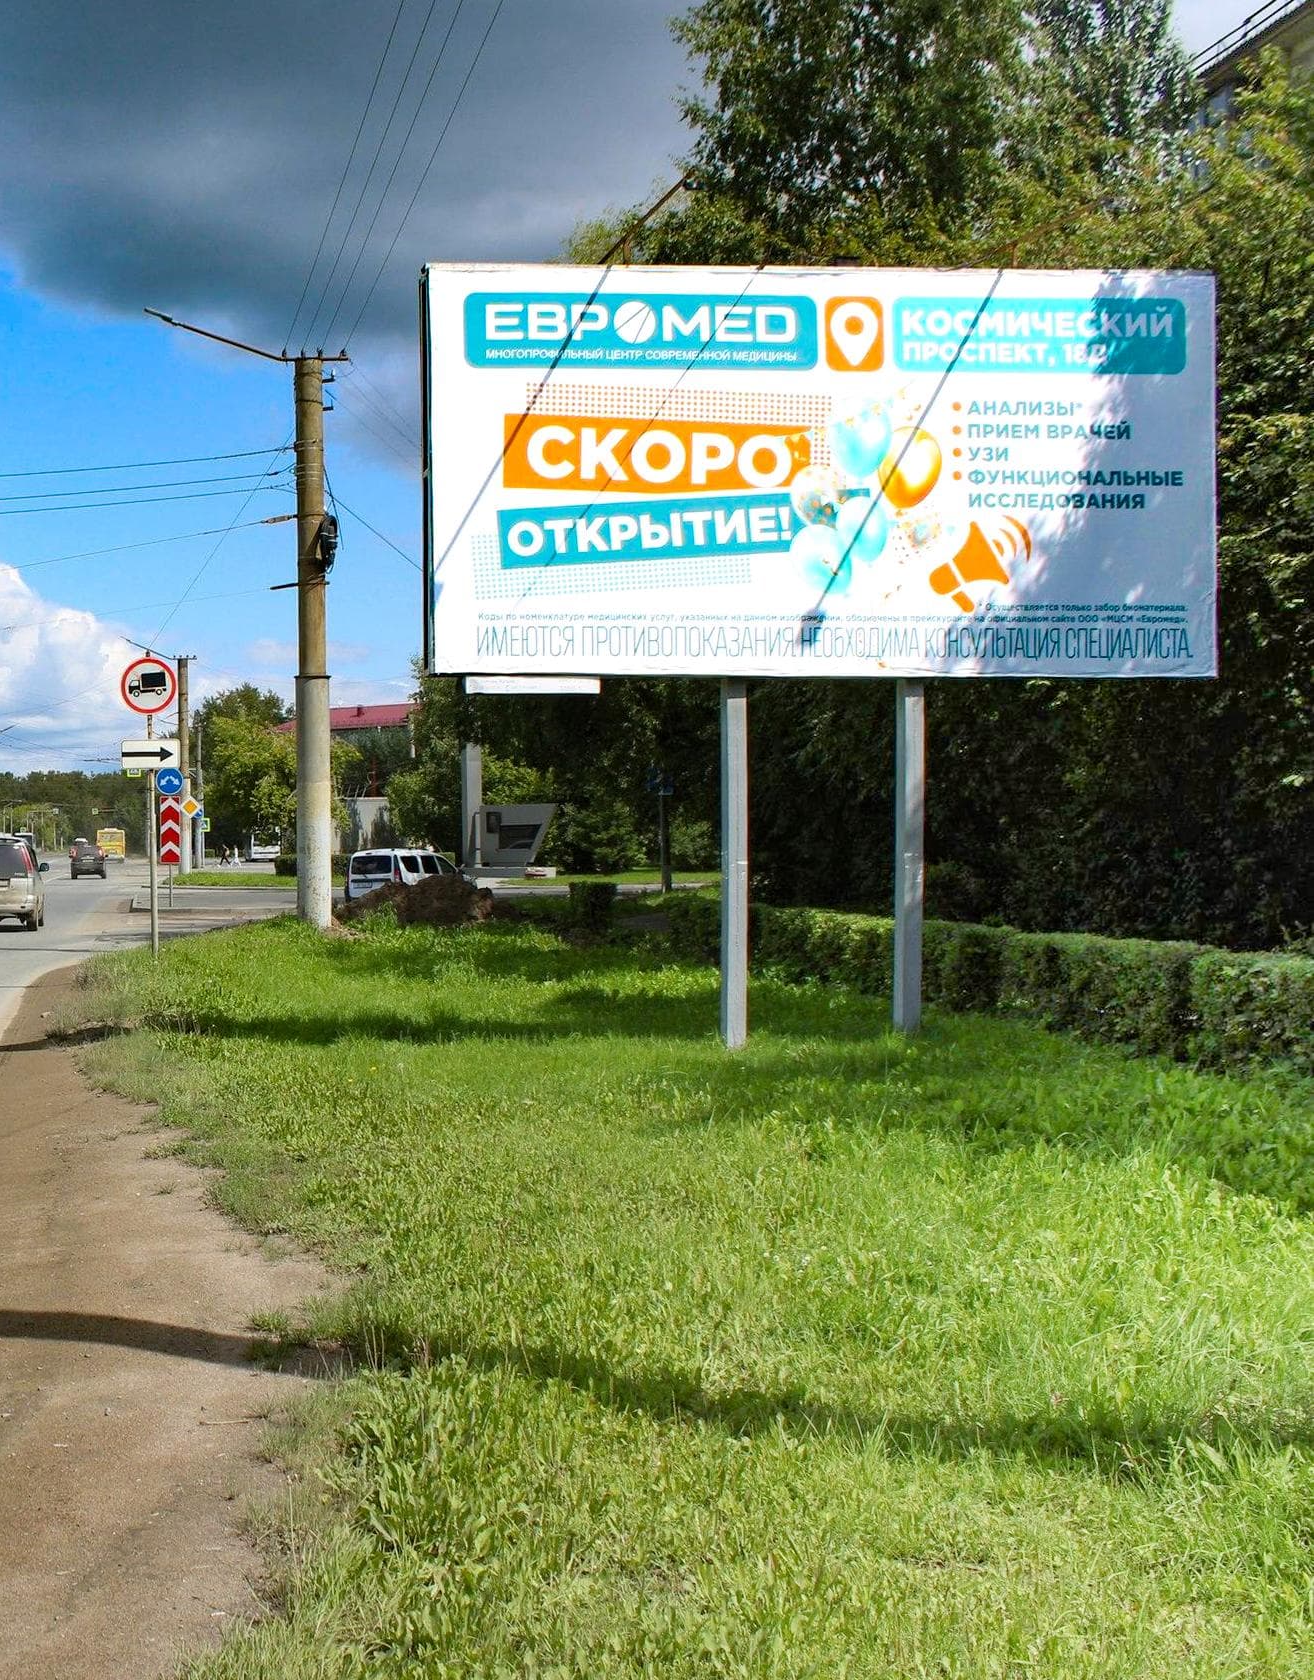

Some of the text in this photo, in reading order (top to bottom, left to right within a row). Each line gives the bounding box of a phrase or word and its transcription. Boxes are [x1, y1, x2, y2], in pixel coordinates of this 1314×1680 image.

[902, 306, 1173, 338] КОСМИЧЕСКИЙ
[606, 349, 643, 361] ЦЕНТР
[645, 349, 730, 362] СОВРЕМЕННОЙ
[732, 351, 798, 363] МЕДИЦИНЫ
[902, 342, 1056, 367] ПРОСПЕКТ,
[967, 420, 1132, 441] ПРИЕМ ВРАЧЕЙ
[526, 425, 793, 488] СКОРО
[967, 447, 1009, 462] УЗИ
[967, 470, 1184, 487] ФУНКЦИОНАЛЬНЫЕ
[967, 493, 1145, 509] ИССЛЕДОВАНИЯ
[506, 506, 792, 558] ОТКРЫТИЕ!
[1061, 603, 1092, 613] только
[1094, 603, 1120, 614] забор
[477, 625, 575, 657] ИМЕЮТСЯ
[800, 626, 921, 659] НЕОБХОДИМА
[925, 627, 1060, 661] КОНСУЛЬТАЦИЯ
